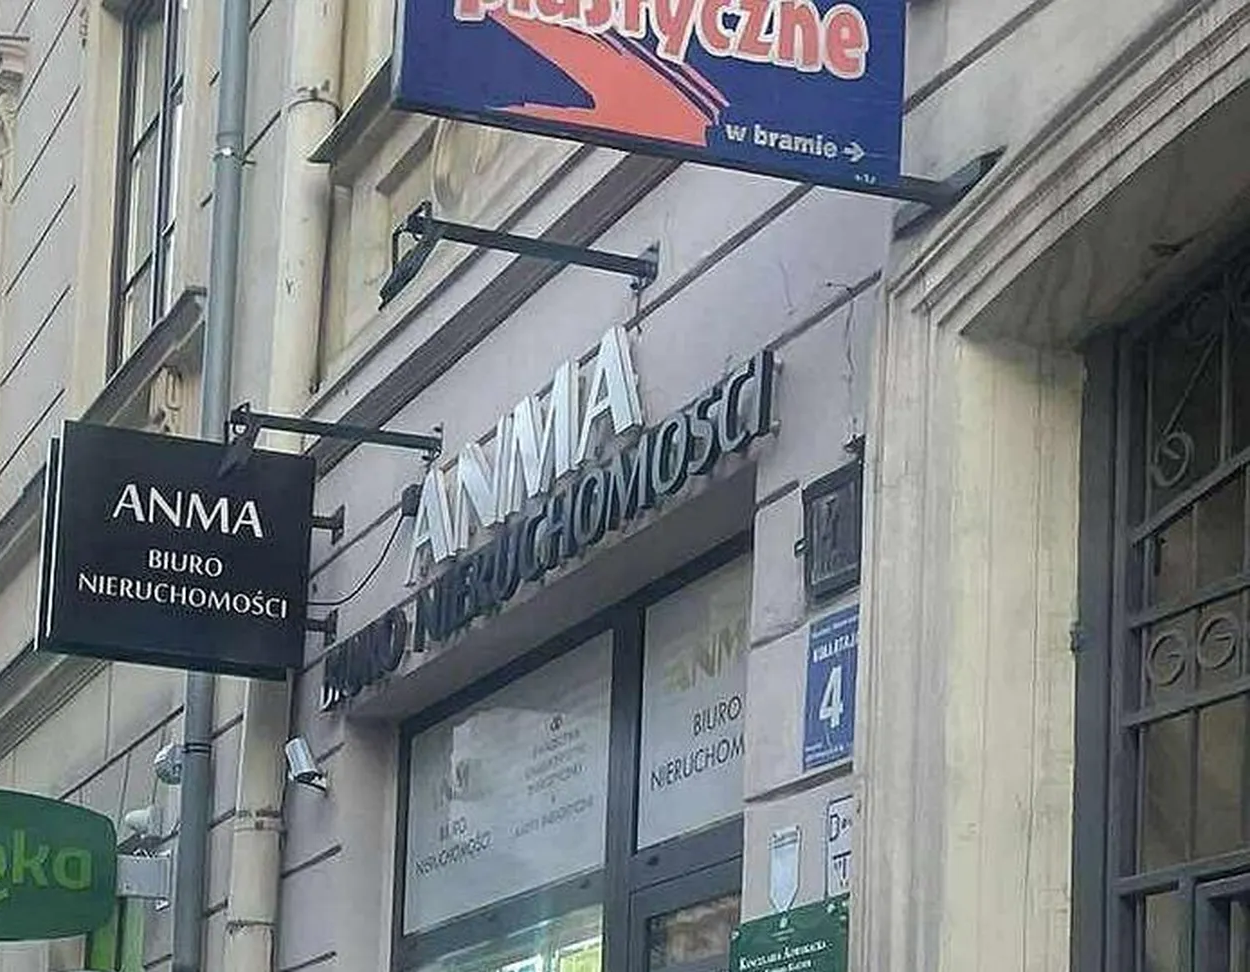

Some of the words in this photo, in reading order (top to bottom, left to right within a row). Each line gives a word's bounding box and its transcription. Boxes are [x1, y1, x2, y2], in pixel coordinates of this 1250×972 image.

[724, 123, 747, 142] w
[753, 124, 838, 159] bramie
[405, 325, 645, 587] ANMA
[112, 483, 264, 539] ANMA
[148, 549, 224, 578] BIURO
[77, 572, 288, 619] NIERUCHOMOŚCI
[692, 696, 743, 738] BIURO
[818, 665, 844, 729] 4
[649, 735, 746, 792] NIERUCHOM
